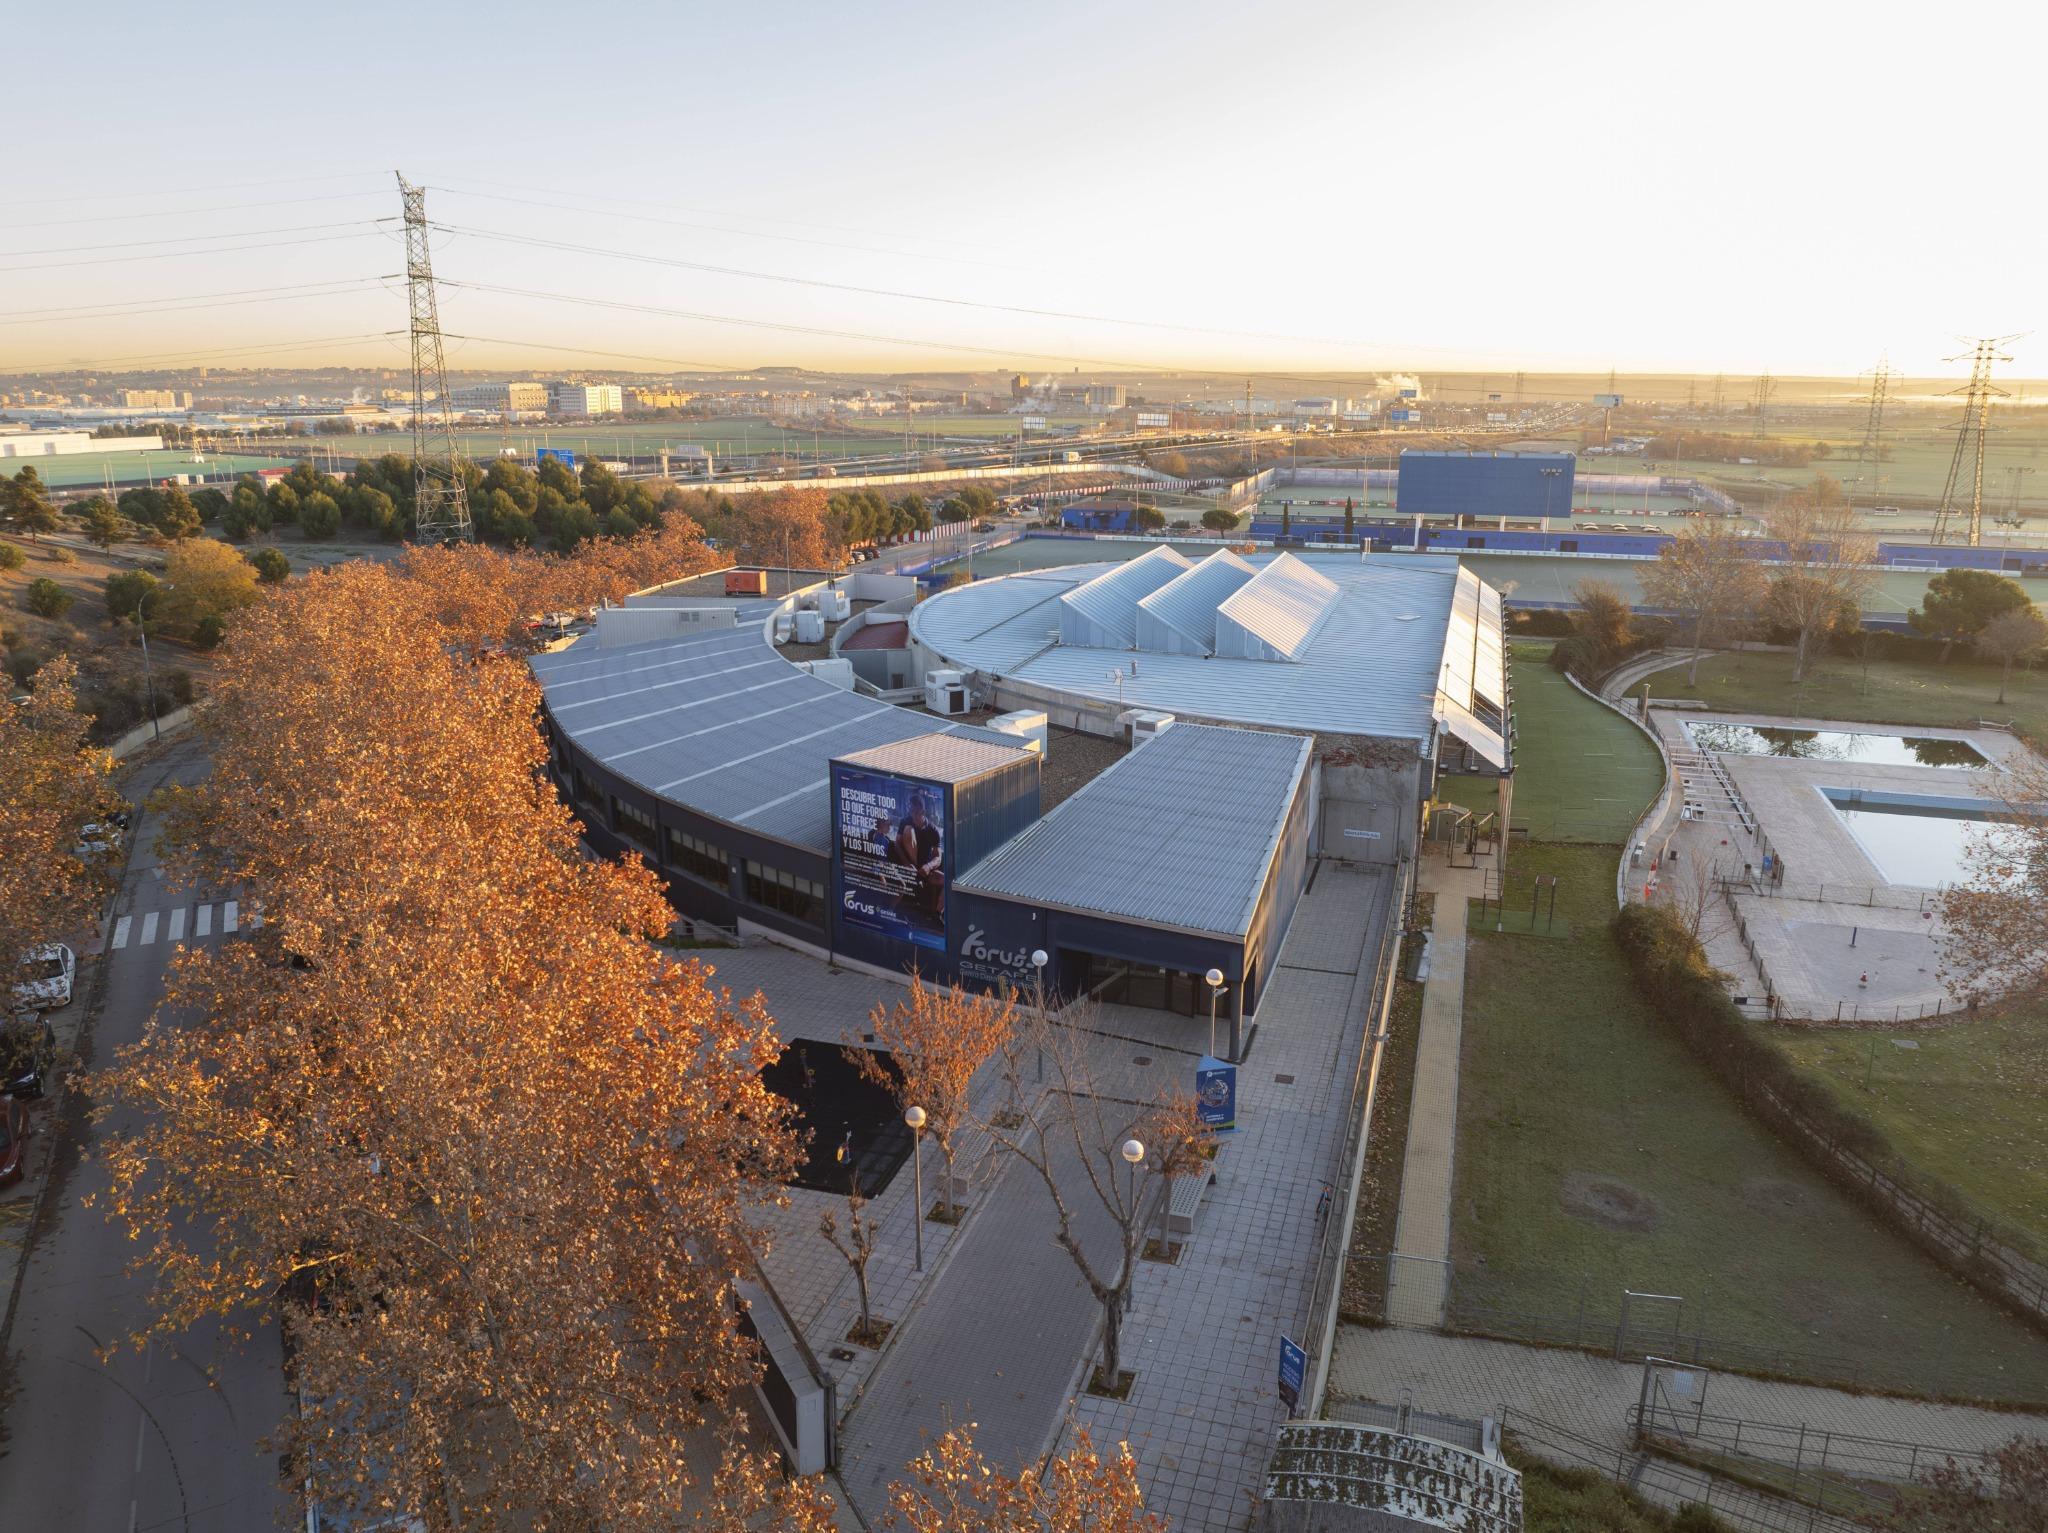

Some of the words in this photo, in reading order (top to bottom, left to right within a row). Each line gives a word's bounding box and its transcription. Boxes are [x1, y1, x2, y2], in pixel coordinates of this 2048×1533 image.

[841, 787, 876, 805] DESCUBRE
[877, 795, 896, 809] TODO
[841, 799, 851, 812] LO
[851, 802, 865, 815] QUE
[865, 805, 889, 820] FORUS
[842, 811, 851, 824] TE
[851, 814, 878, 830] OFRECE
[842, 824, 861, 839] PARA
[861, 828, 869, 840] TI
[842, 836, 848, 848] Y
[849, 837, 862, 851] LOS
[862, 840, 887, 857] TUYOS.
[960, 961, 1037, 982] GETAFE
